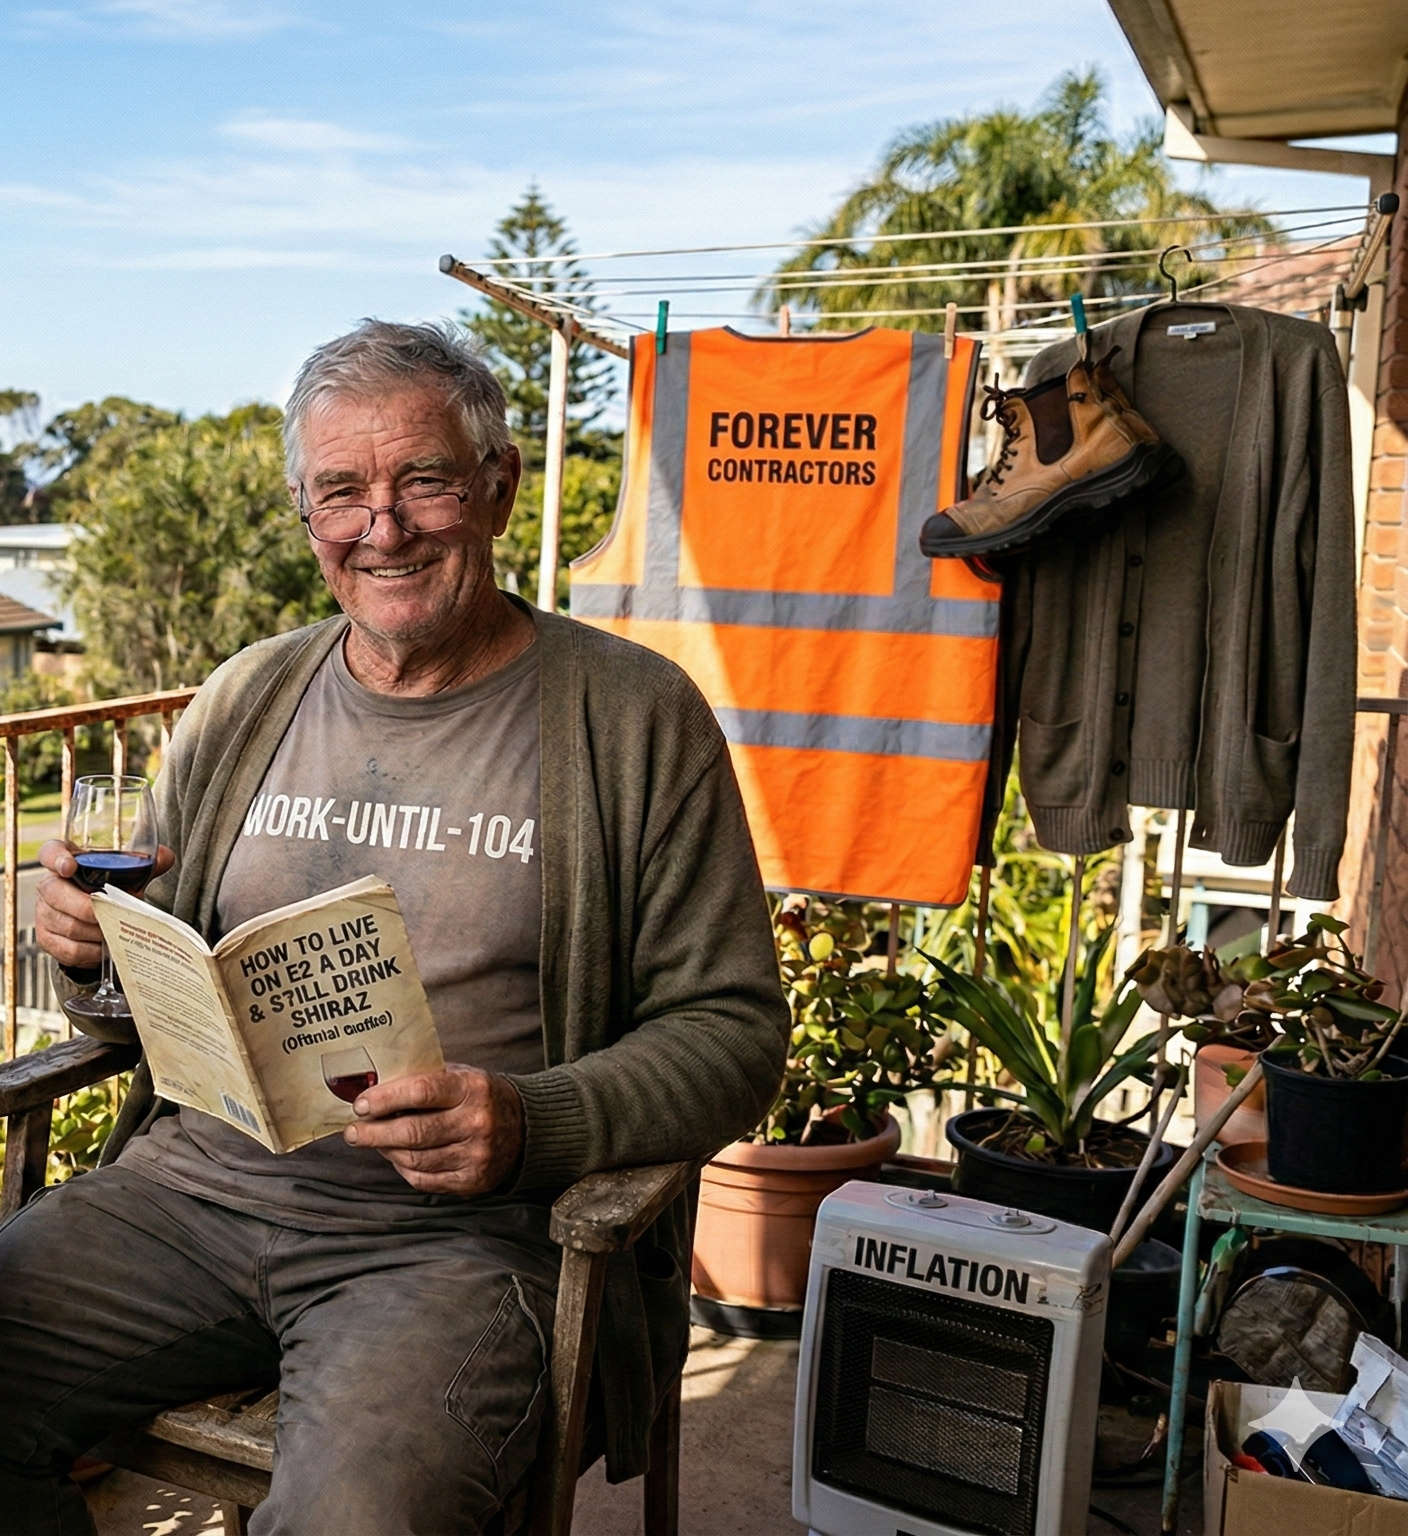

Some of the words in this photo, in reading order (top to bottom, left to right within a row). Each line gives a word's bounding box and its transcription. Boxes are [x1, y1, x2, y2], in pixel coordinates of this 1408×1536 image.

[709, 411, 878, 450] FOREVER
[707, 458, 877, 486] CONTRACTORS
[242, 793, 536, 864] WORK-UNTIL-104
[239, 942, 289, 978] HOW
[292, 932, 324, 955] TO
[328, 914, 379, 946] LIVE
[250, 970, 282, 997] ON
[319, 953, 336, 974] A
[338, 937, 381, 967] DAY
[248, 1003, 266, 1024] &
[331, 956, 402, 994] DRINK
[290, 991, 373, 1029] SHIRAZ
[853, 1236, 1030, 1304] INFLATION
